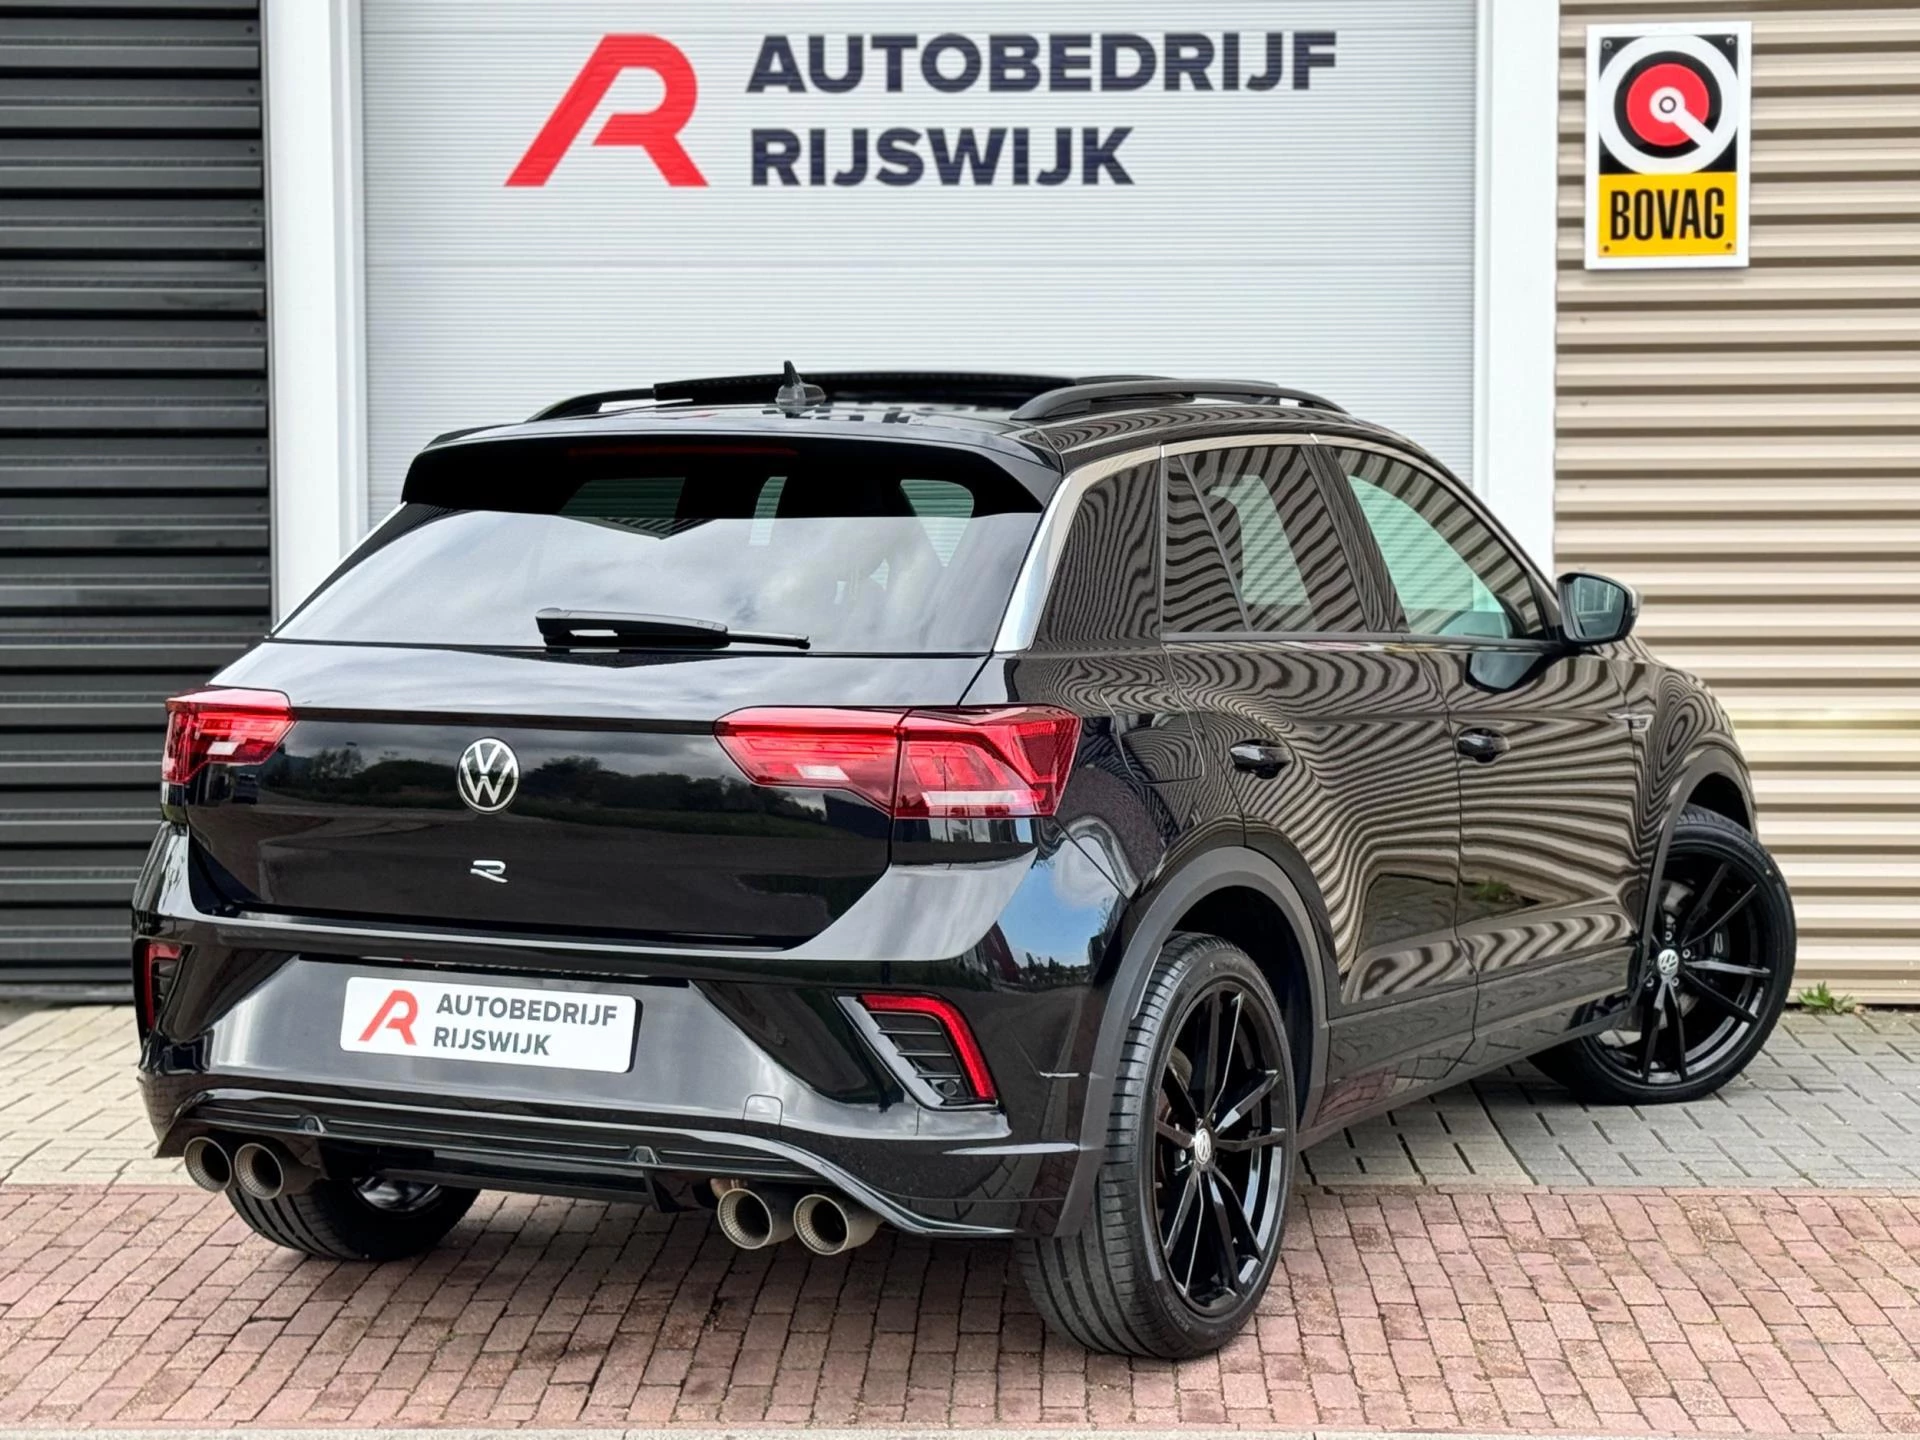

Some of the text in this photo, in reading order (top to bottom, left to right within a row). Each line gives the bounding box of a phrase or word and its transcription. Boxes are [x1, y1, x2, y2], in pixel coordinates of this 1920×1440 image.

[746, 31, 1337, 94] AUTOBEDRIJF
[750, 126, 1135, 187] RIJSWIJK
[1609, 187, 1725, 241] BOVAG
[470, 860, 508, 883] R
[436, 993, 617, 1027] AUTOBEDRIJF
[433, 1026, 552, 1056] RIJSWIJK
